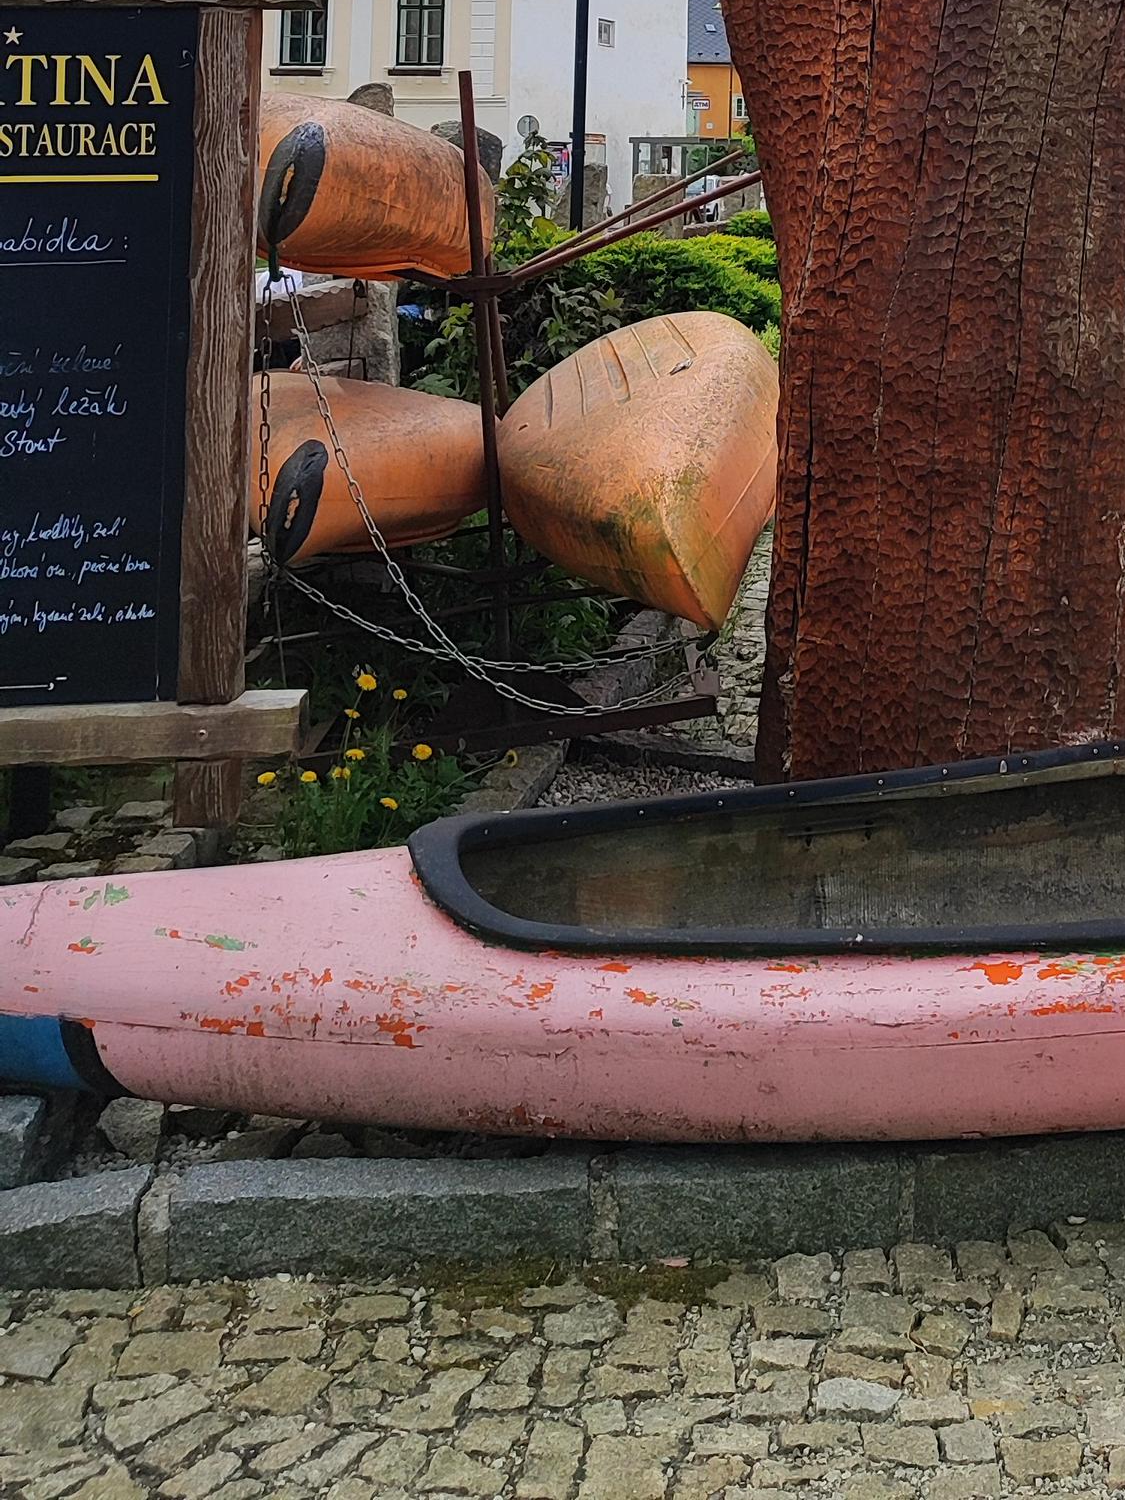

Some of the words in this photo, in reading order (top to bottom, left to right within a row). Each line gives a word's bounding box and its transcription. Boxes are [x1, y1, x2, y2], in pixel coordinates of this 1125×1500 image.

[0, 54, 170, 106] TINA
[51, 385, 128, 416] ležák
[0, 427, 68, 457] Stout
